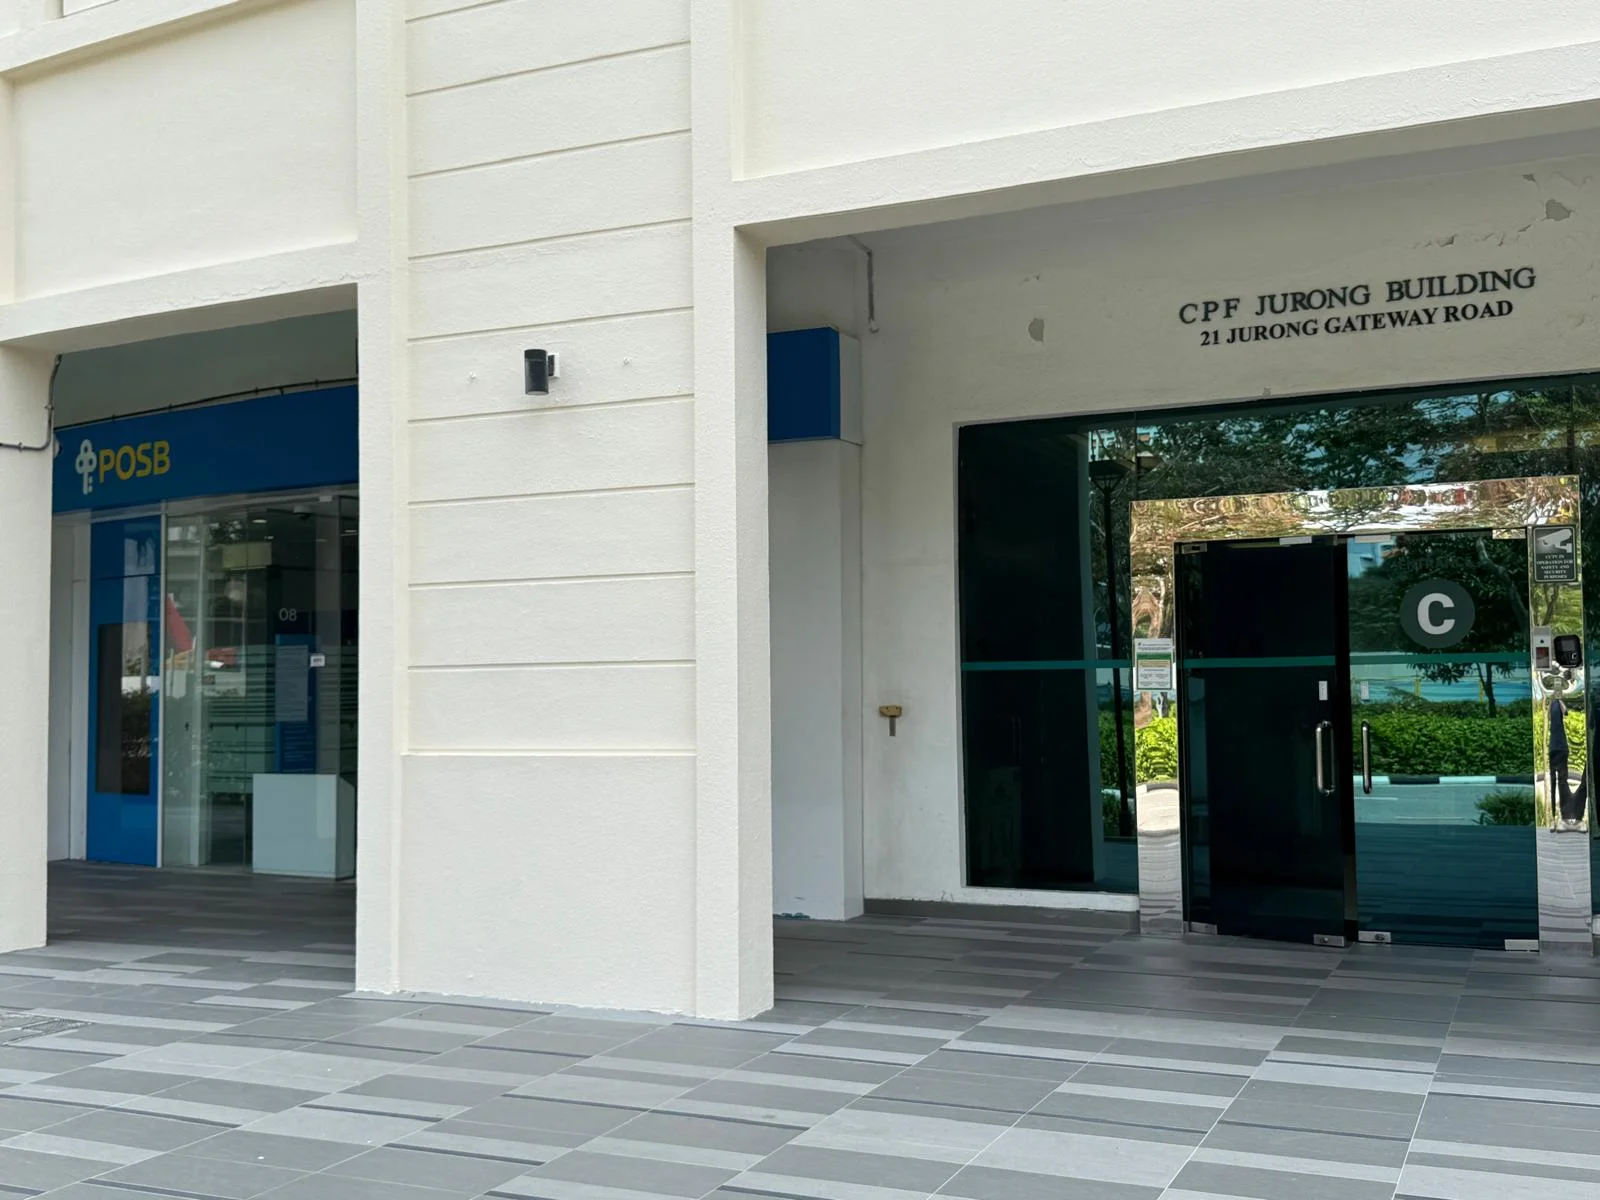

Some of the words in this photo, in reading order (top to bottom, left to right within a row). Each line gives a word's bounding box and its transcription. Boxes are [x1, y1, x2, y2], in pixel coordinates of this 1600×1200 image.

[1179, 298, 1241, 325] CPF
[1255, 284, 1371, 316] JURONG
[1385, 267, 1537, 302] BUILDING
[1200, 329, 1220, 346] 21
[1226, 319, 1319, 344] JURONG
[1324, 307, 1439, 334] GATEWAY
[1443, 300, 1514, 323] ROAD
[98, 440, 171, 484] POSB
[279, 607, 298, 622] 08
[1417, 592, 1456, 635] C
